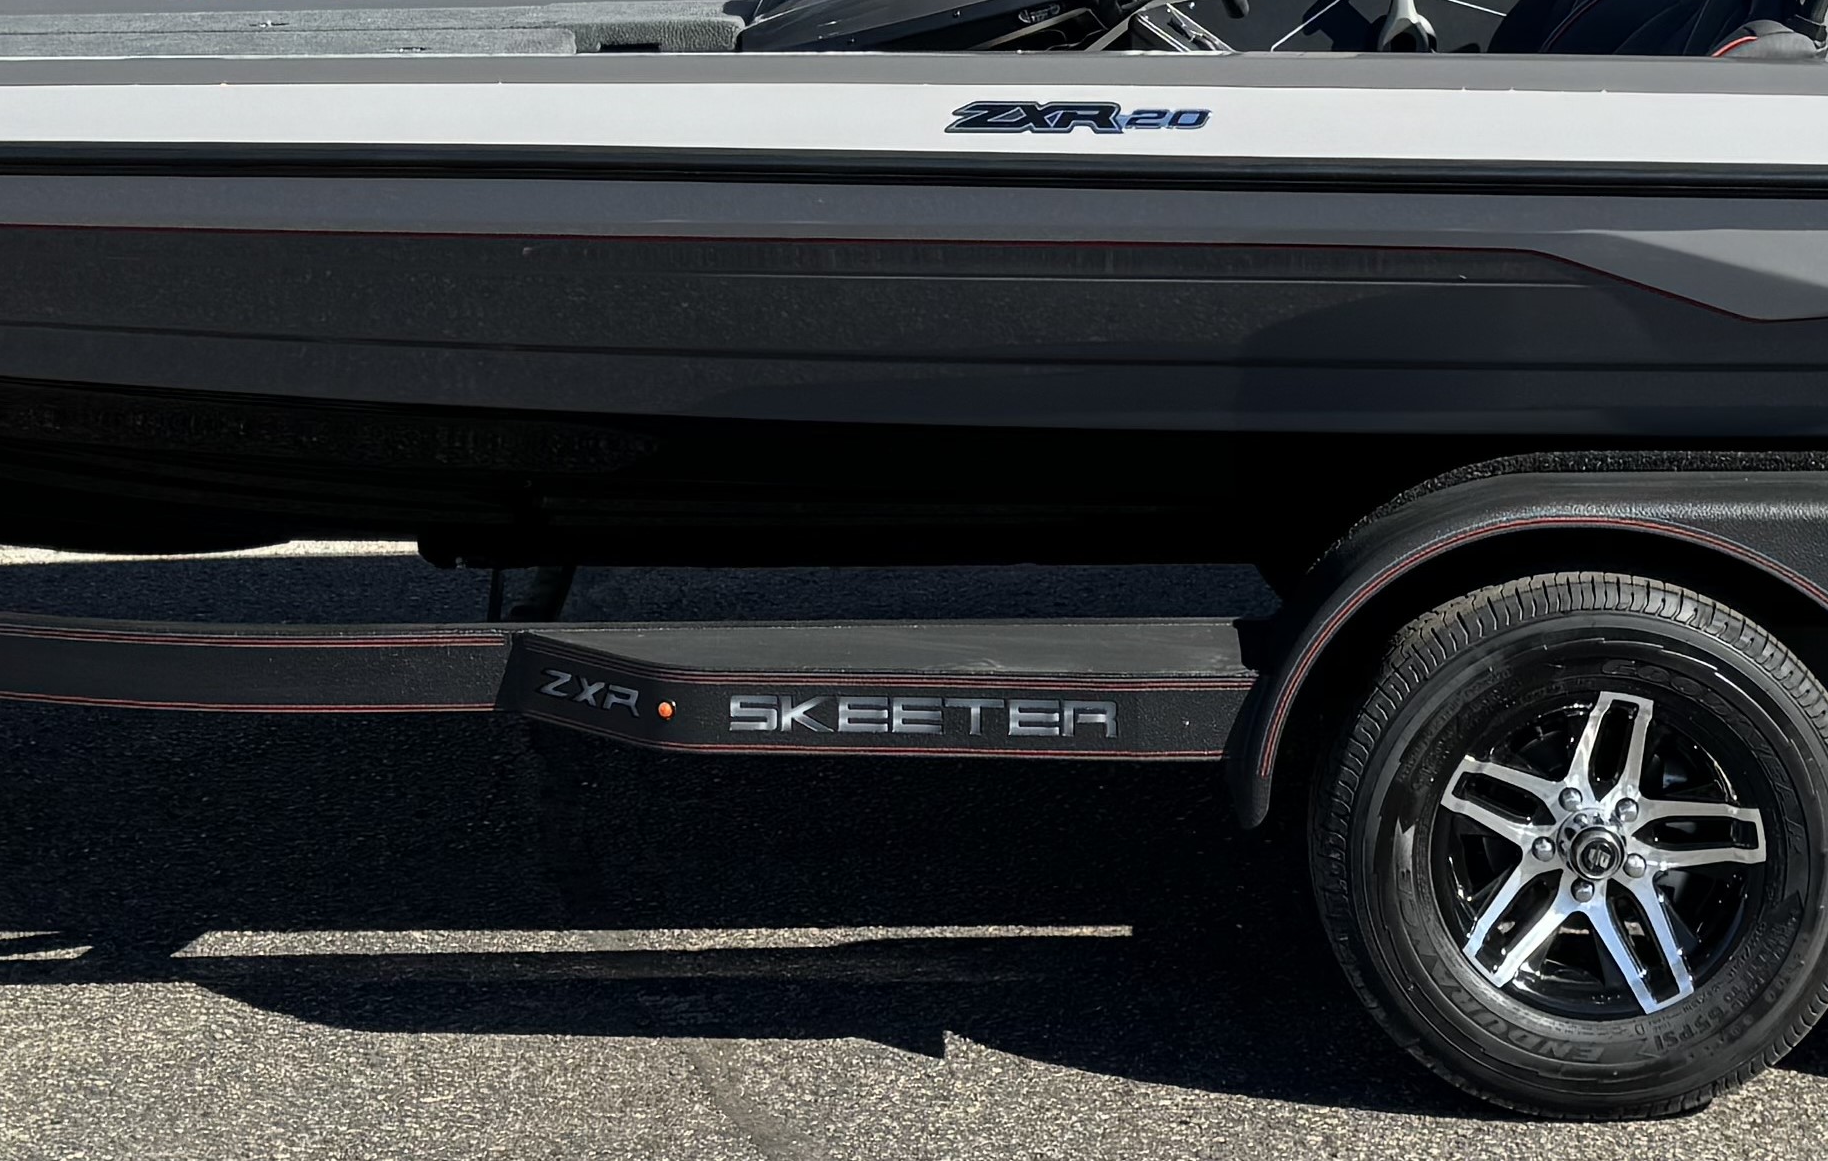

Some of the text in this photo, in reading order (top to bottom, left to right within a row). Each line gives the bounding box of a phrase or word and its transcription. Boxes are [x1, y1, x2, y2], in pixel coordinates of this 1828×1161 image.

[945, 100, 1212, 135] ZXR 20
[536, 669, 642, 719] ZXR
[729, 694, 1120, 740] SKEETER
